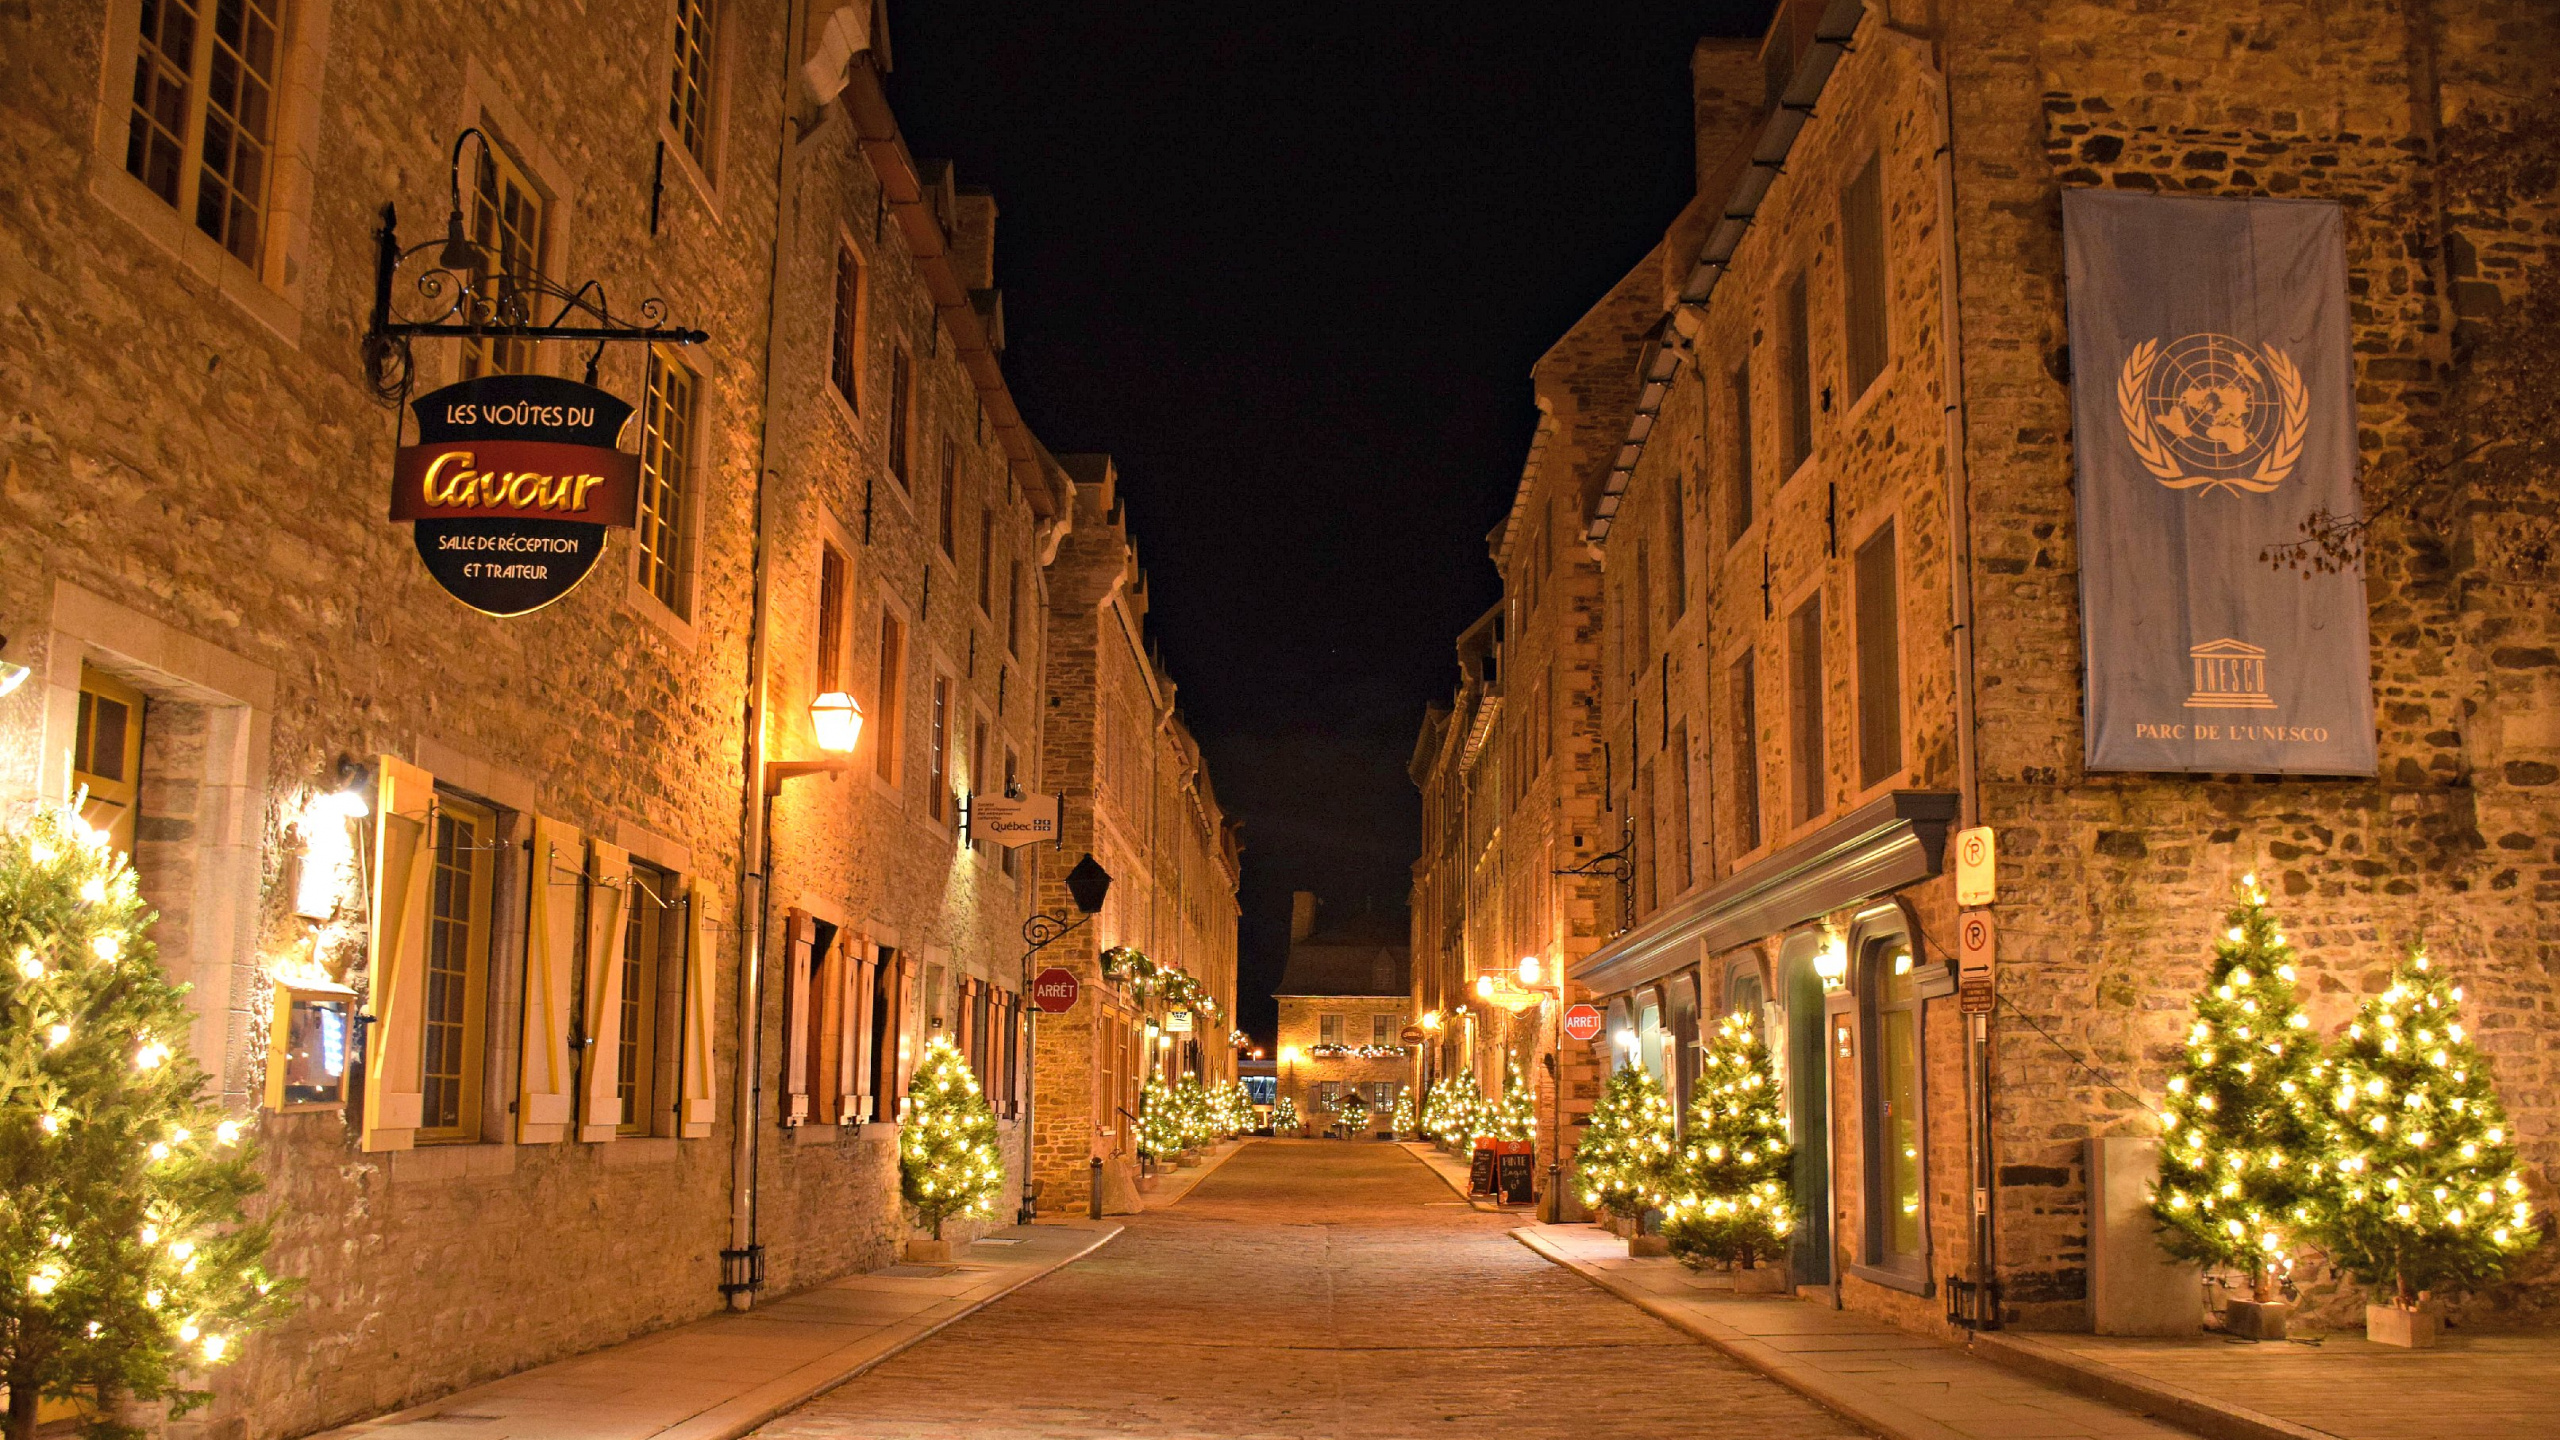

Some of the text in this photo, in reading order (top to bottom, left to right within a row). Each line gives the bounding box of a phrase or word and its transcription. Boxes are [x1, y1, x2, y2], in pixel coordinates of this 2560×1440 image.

[446, 400, 594, 427] LES VOÛTES DU
[423, 451, 605, 512] Cavour
[438, 533, 579, 553] SALLE DE RÉCEPTION
[463, 563, 548, 580] ET TRAITEUR
[2194, 658, 2265, 693] UNESCO
[2136, 723, 2328, 742] PARC DE L'UNESCO
[990, 820, 1032, 833] Québec
[1037, 982, 1075, 998] ARRÊT
[1567, 1014, 1599, 1027] ARRÊT
